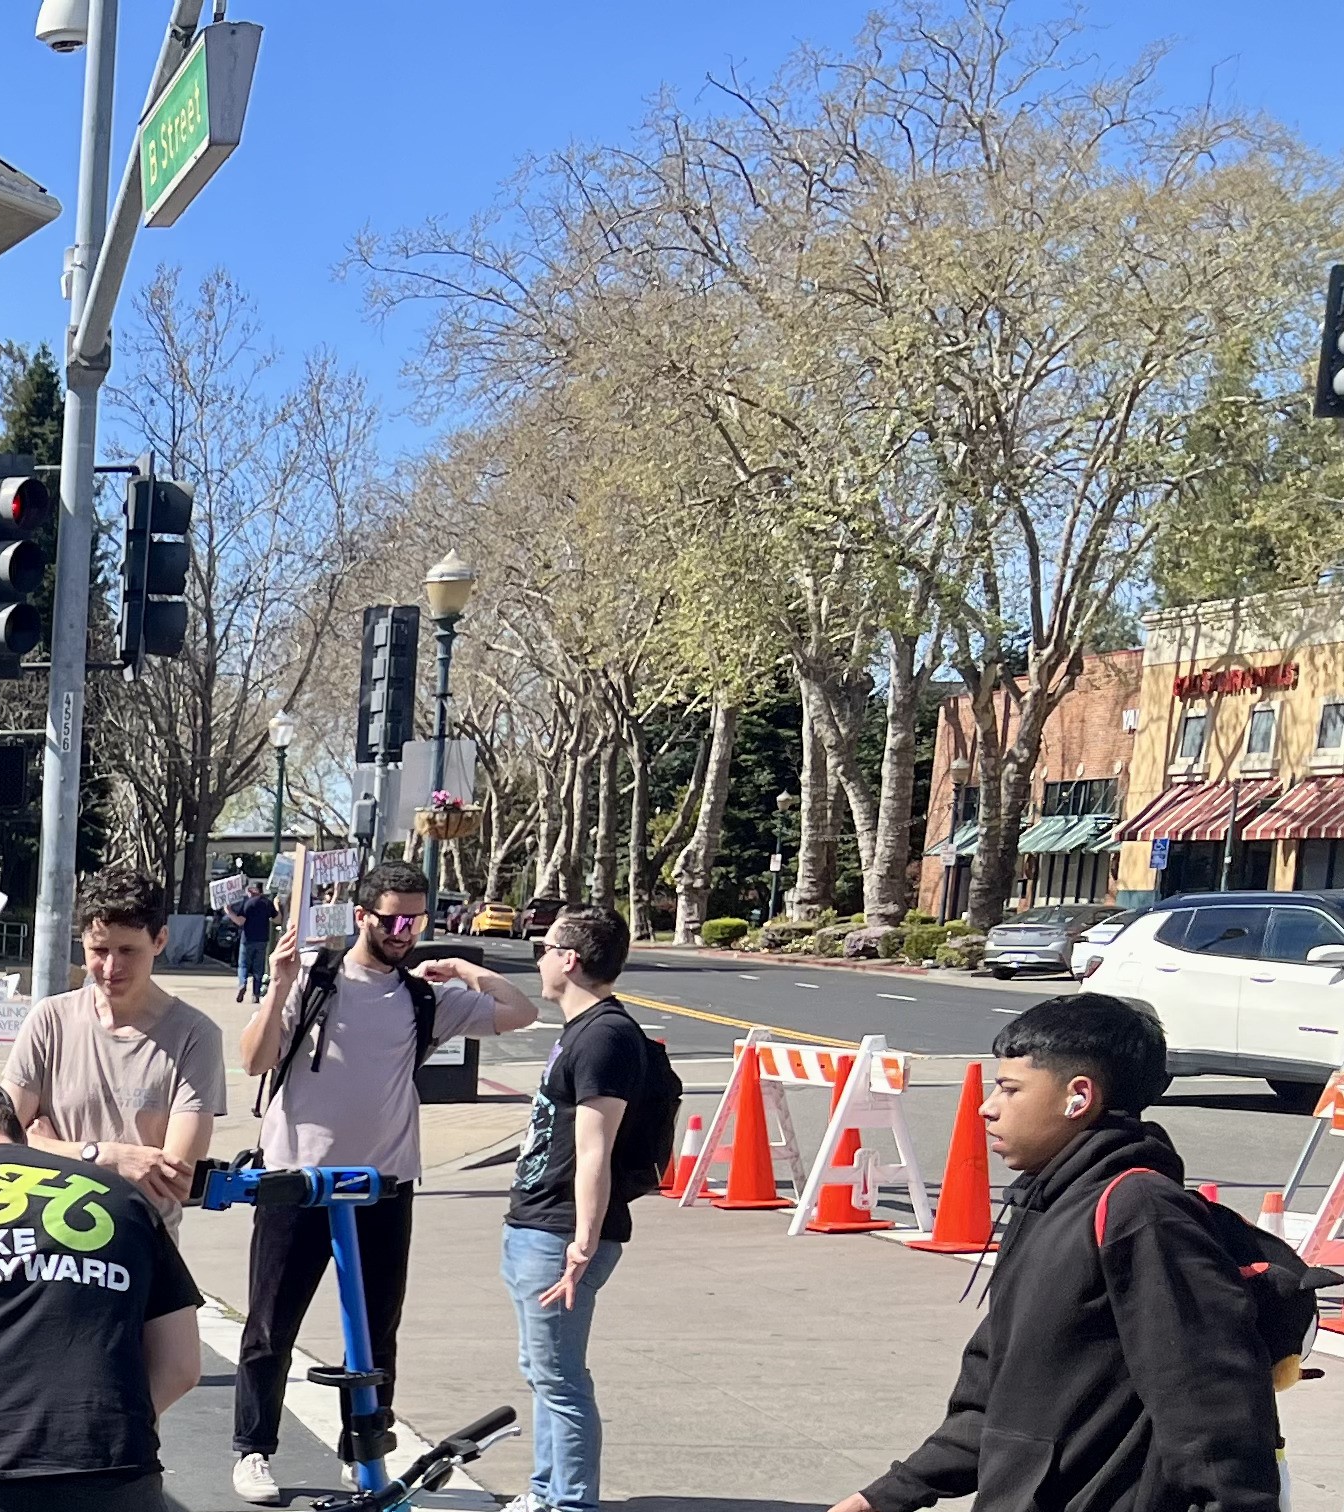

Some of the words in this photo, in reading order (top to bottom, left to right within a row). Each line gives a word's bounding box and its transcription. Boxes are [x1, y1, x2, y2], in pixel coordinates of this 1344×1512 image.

[149, 139, 157, 187] B
[160, 79, 202, 169] Street
[226, 878, 241, 891] OUT
